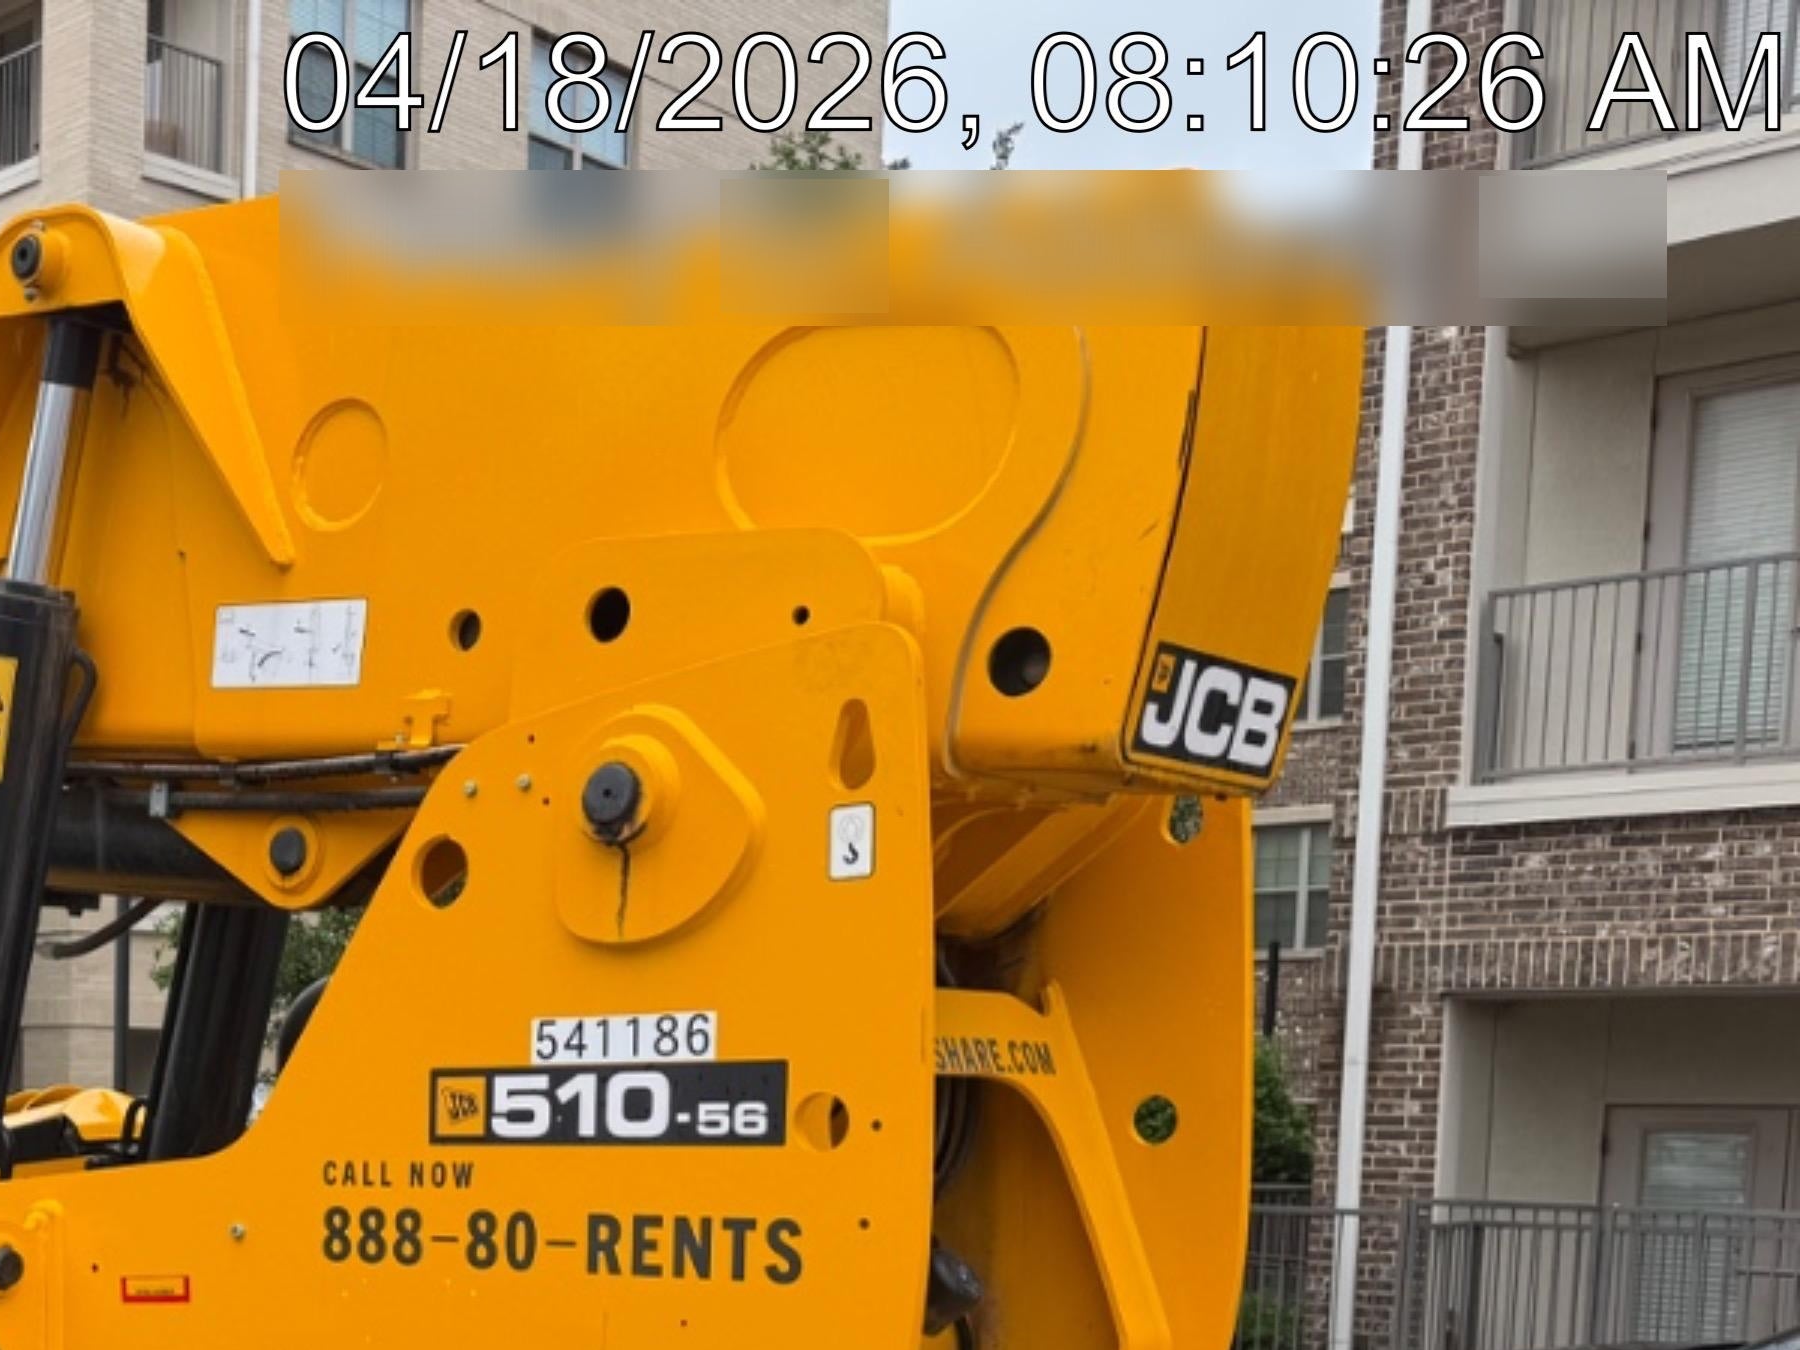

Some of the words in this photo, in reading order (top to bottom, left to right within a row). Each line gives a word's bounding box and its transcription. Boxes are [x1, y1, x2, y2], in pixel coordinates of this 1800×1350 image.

[1141, 658, 1289, 767] JCB
[535, 1013, 712, 1061] 541186
[322, 1161, 393, 1188] CALL
[408, 1162, 475, 1190] NOW
[322, 1206, 804, 1286] 888-80-RENTS
